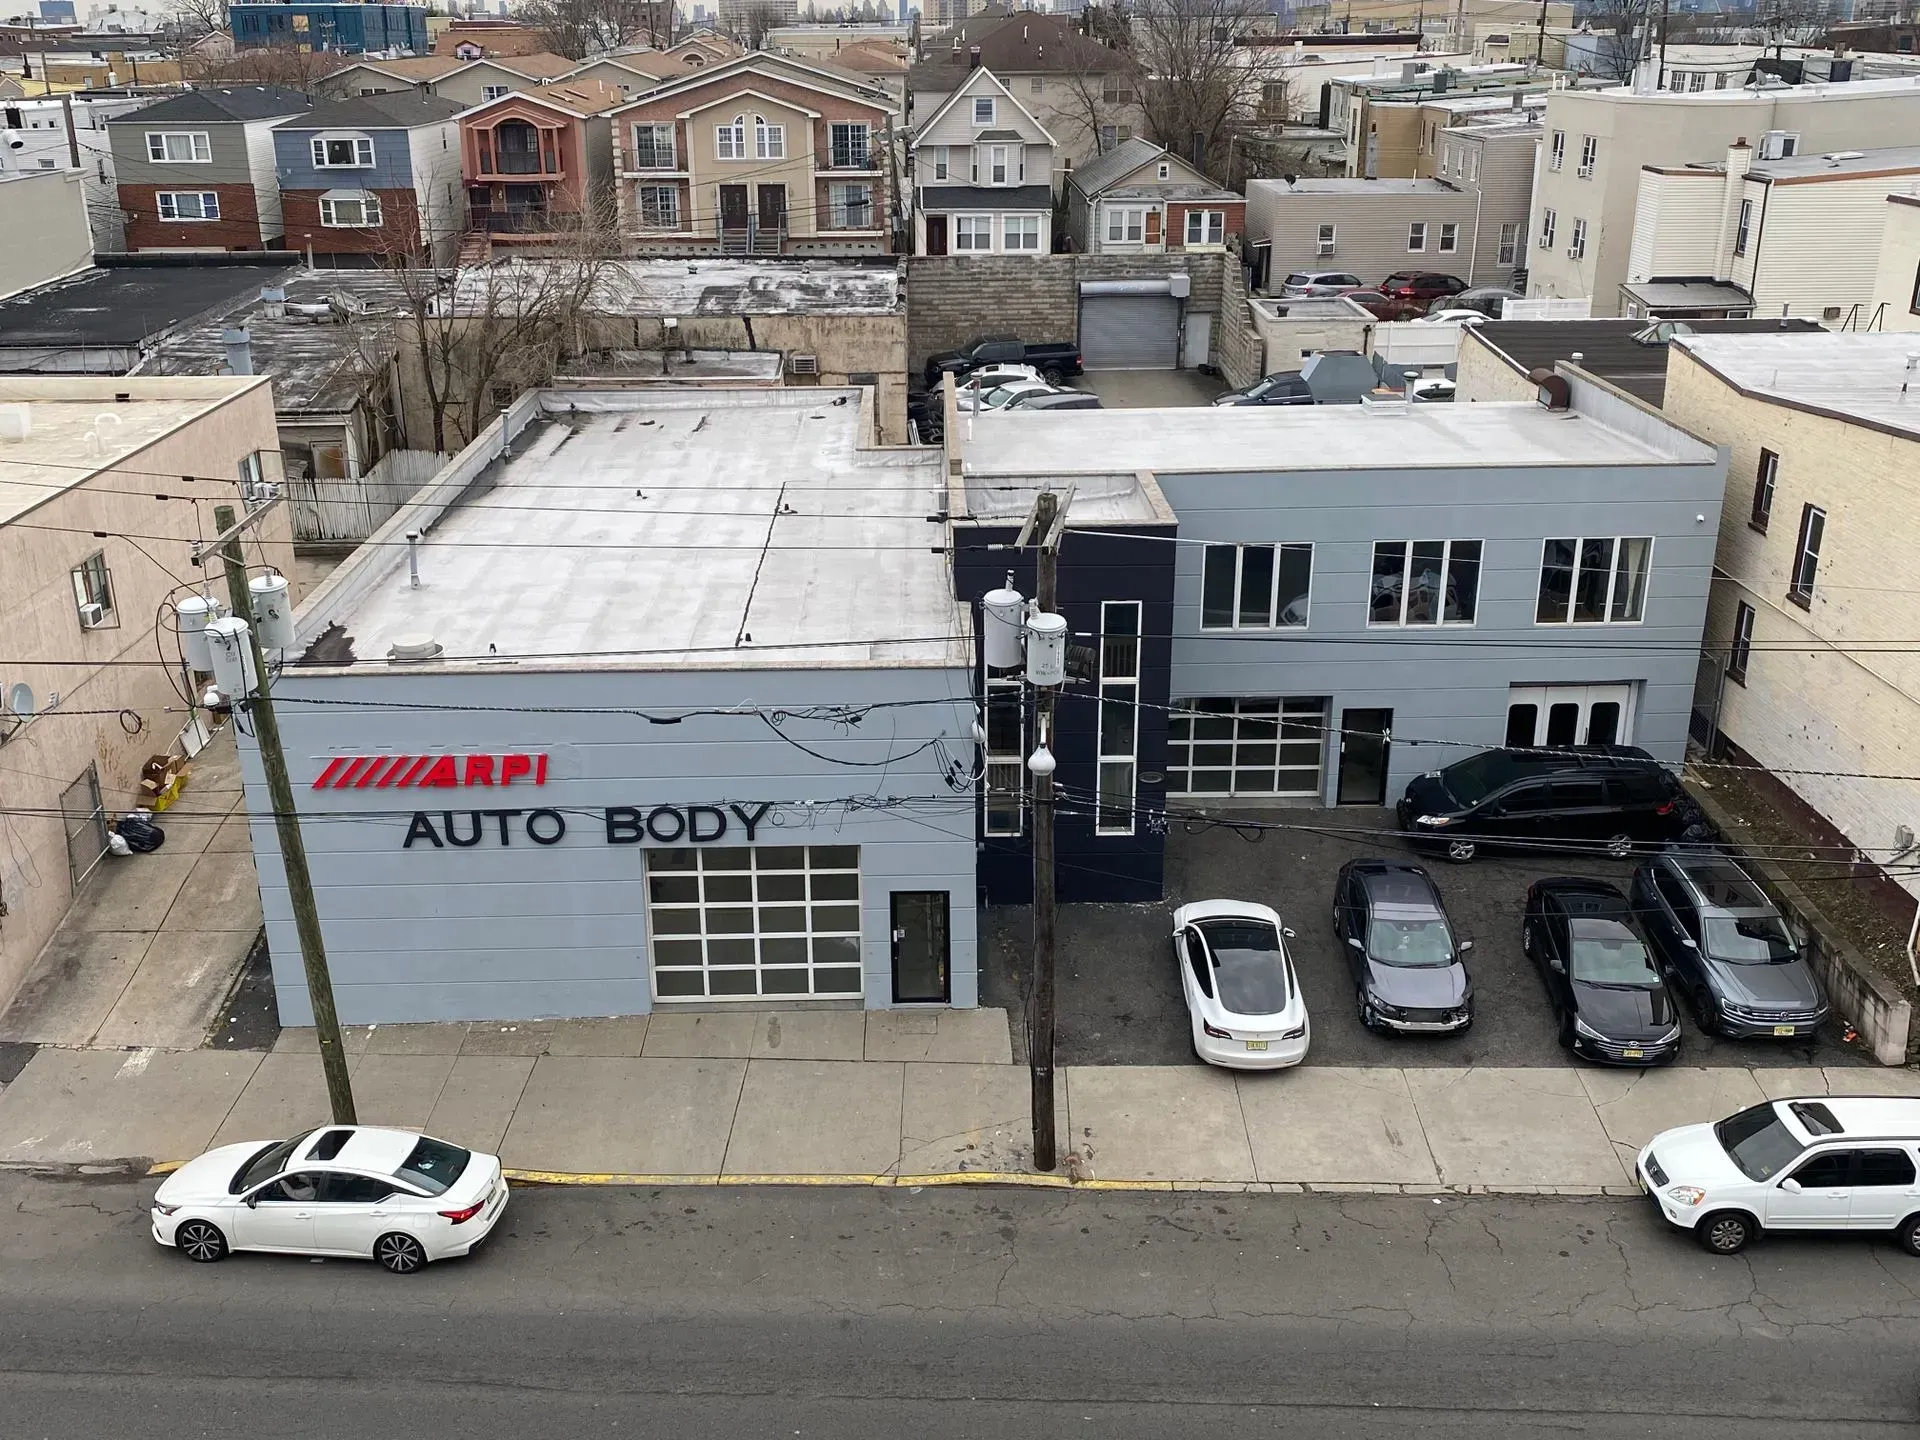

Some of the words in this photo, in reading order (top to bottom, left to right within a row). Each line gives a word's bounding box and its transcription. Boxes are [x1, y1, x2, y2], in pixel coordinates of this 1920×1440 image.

[417, 753, 548, 788] ARPI
[403, 809, 566, 848] AUTO
[605, 802, 771, 844] BODY
